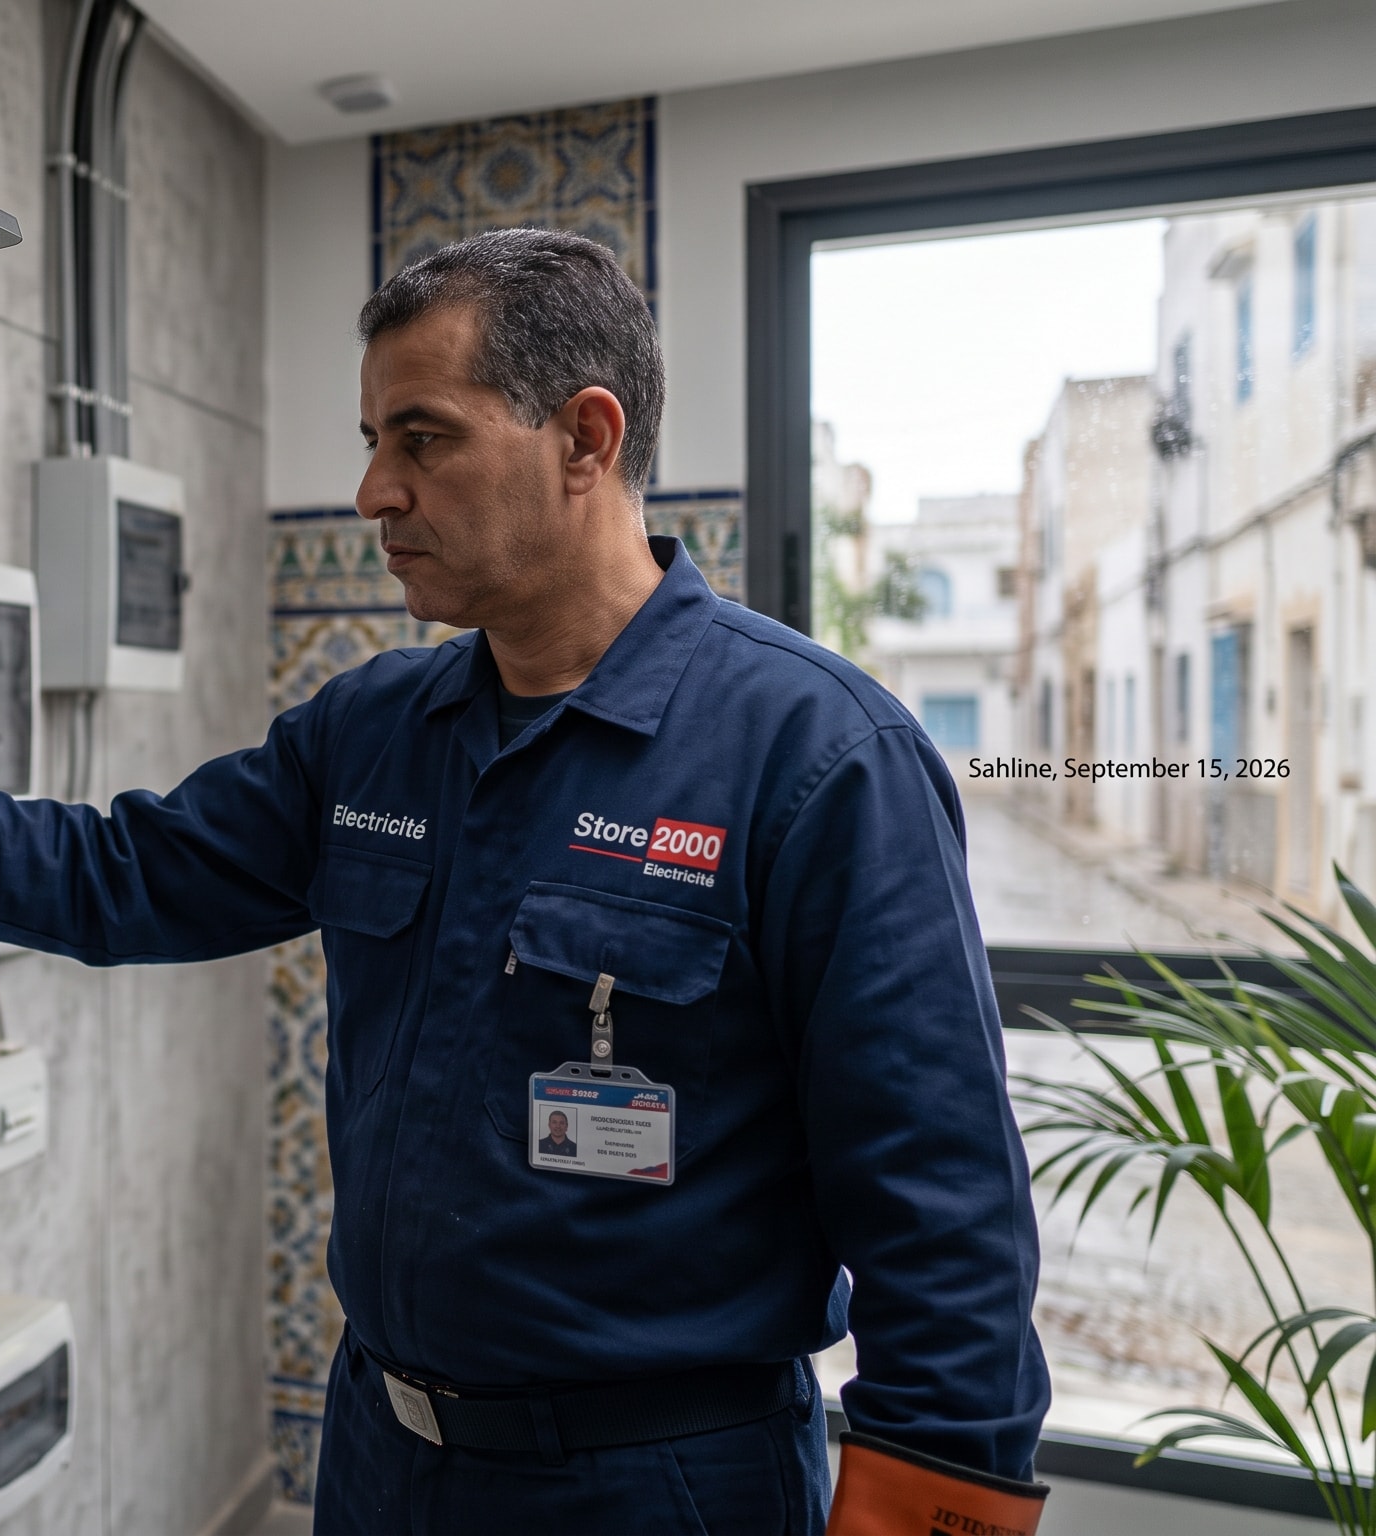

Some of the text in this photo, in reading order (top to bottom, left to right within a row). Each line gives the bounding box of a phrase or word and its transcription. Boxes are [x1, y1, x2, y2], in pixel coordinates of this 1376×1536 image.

[332, 803, 427, 841] Electricité
[573, 811, 722, 863] Store 2000
[642, 861, 716, 888] Electricité
